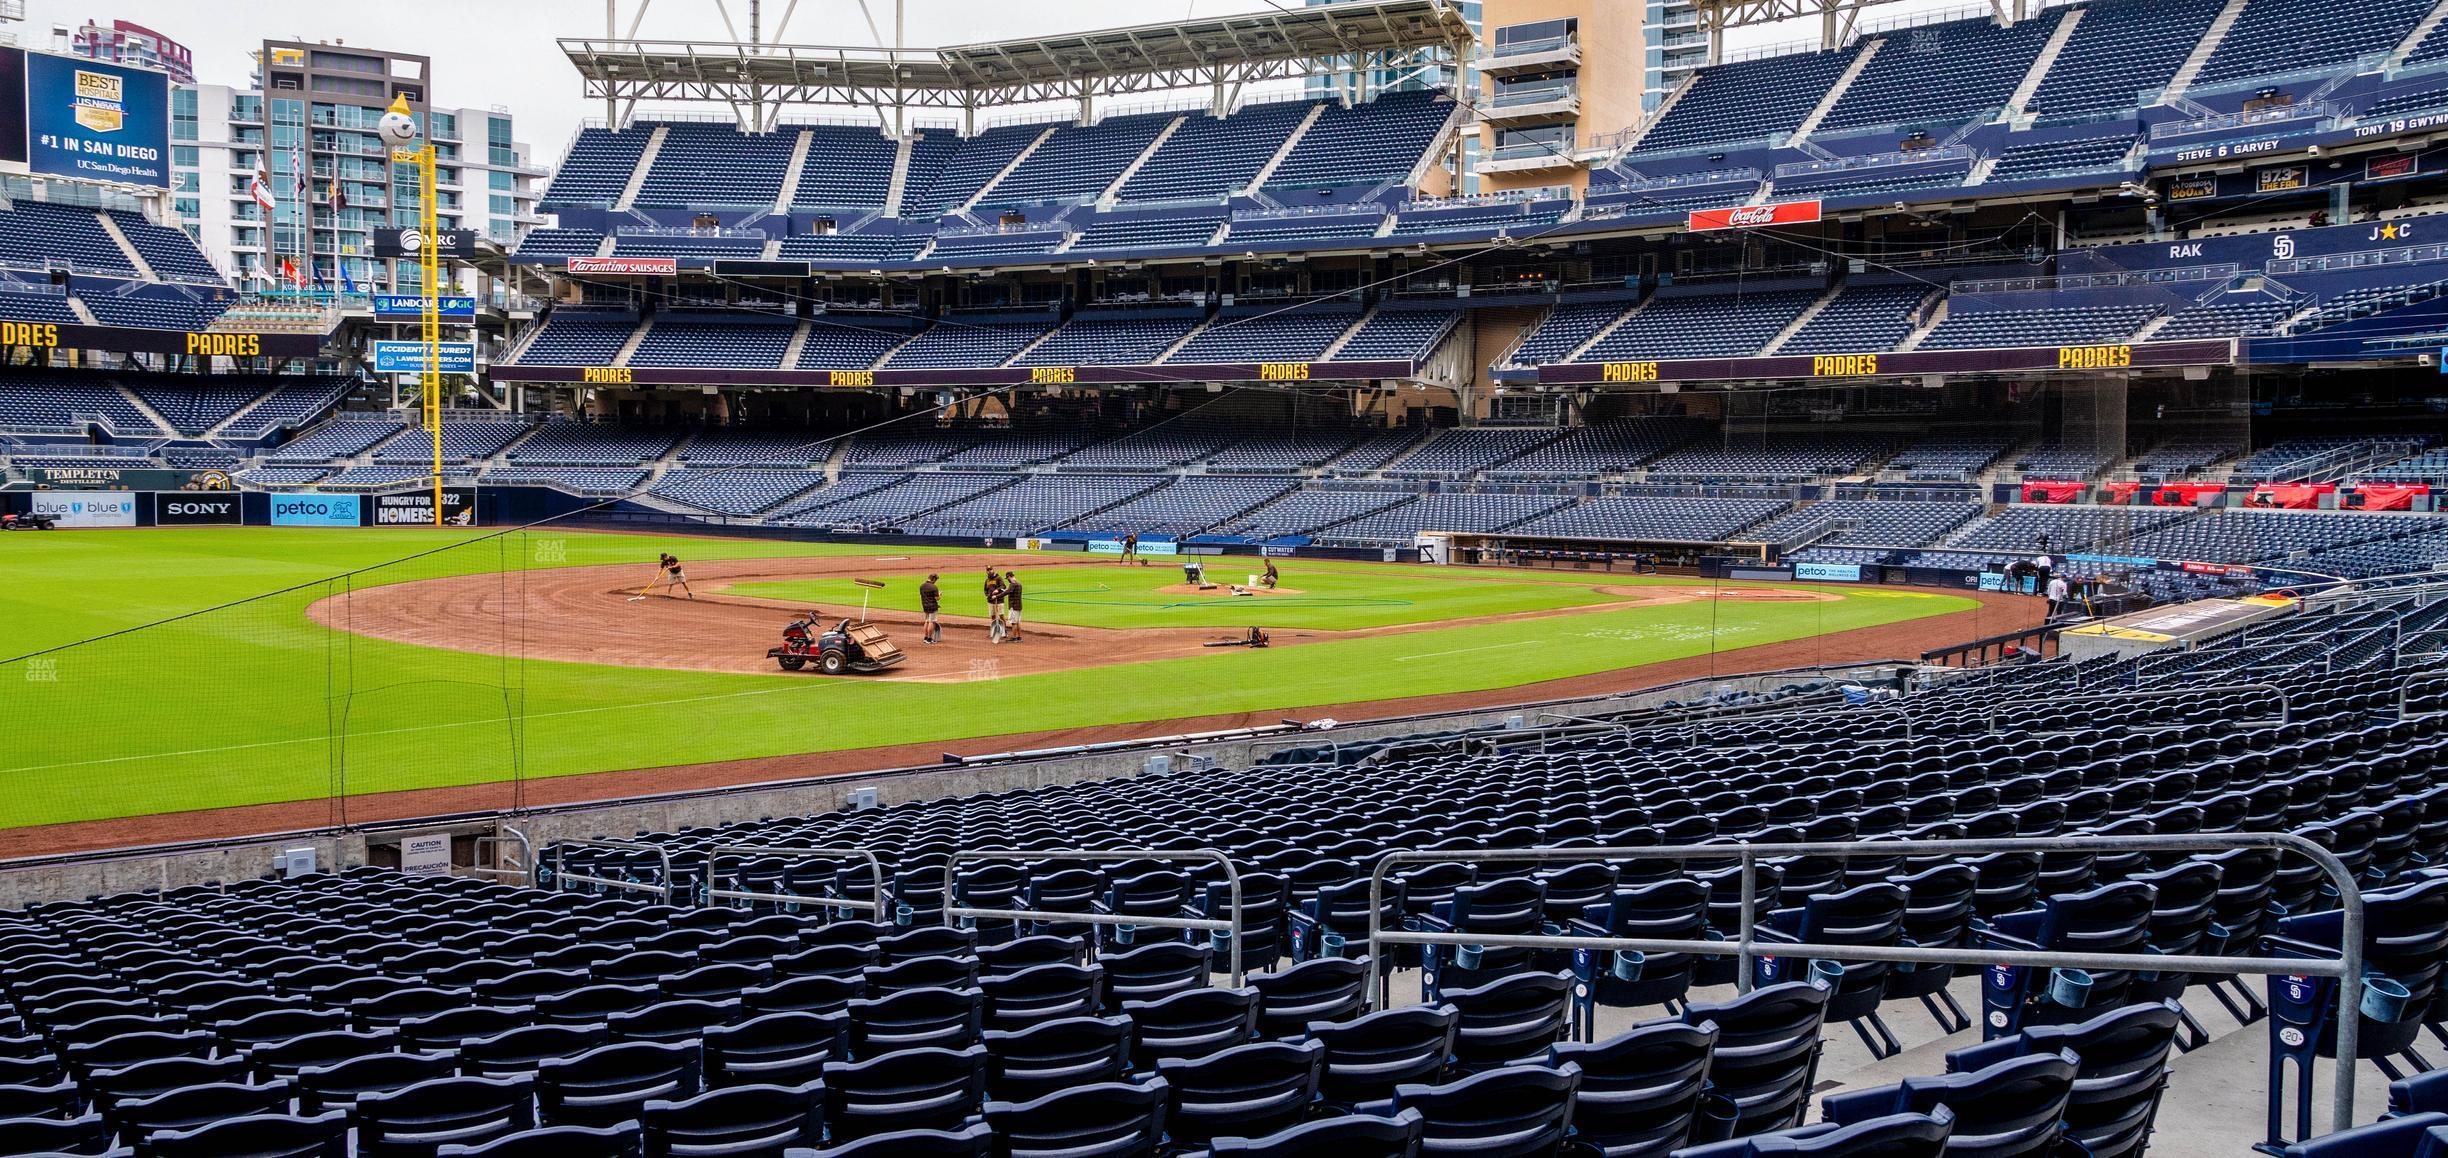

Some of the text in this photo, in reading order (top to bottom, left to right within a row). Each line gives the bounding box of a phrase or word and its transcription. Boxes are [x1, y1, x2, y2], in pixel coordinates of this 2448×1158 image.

[79, 73, 120, 90] BEST
[78, 86, 120, 100] HOSPITALS
[2354, 124, 2385, 137] TONY
[2389, 119, 2406, 133] 19
[41, 134, 158, 161] #1 IN SAN DIEGO
[2177, 140, 2279, 161] STEVE 6 GARVEY
[77, 159, 158, 177] UC San Diego Health
[2261, 180, 2298, 190] THE FAN
[2170, 244, 2202, 259] RAK
[571, 259, 675, 273] Tarantino SAUSAGES
[443, 299, 473, 309] LOGIC
[187, 332, 259, 356] PADRES
[2059, 345, 2131, 370] PADRES
[1261, 363, 1309, 380] PADRES
[1603, 361, 1657, 382] PADRES
[1814, 354, 1877, 377] PADRES
[585, 367, 632, 384] PADRES
[831, 370, 873, 387] PADRES
[1032, 367, 1075, 384] PADRES
[44, 469, 120, 480] TEMPLETON
[381, 496, 431, 505] HUNGRY FOR
[441, 493, 460, 505] 322
[36, 501, 68, 513] blue
[87, 501, 118, 513] blue
[168, 503, 231, 515] SONY
[276, 501, 328, 518] petco
[378, 507, 436, 523] HOMERS
[1797, 567, 1827, 576] petco
[410, 840, 442, 848] CAUTION
[404, 862, 449, 872] PRECAUCIÓN
[2285, 1030, 2299, 1042] 20
